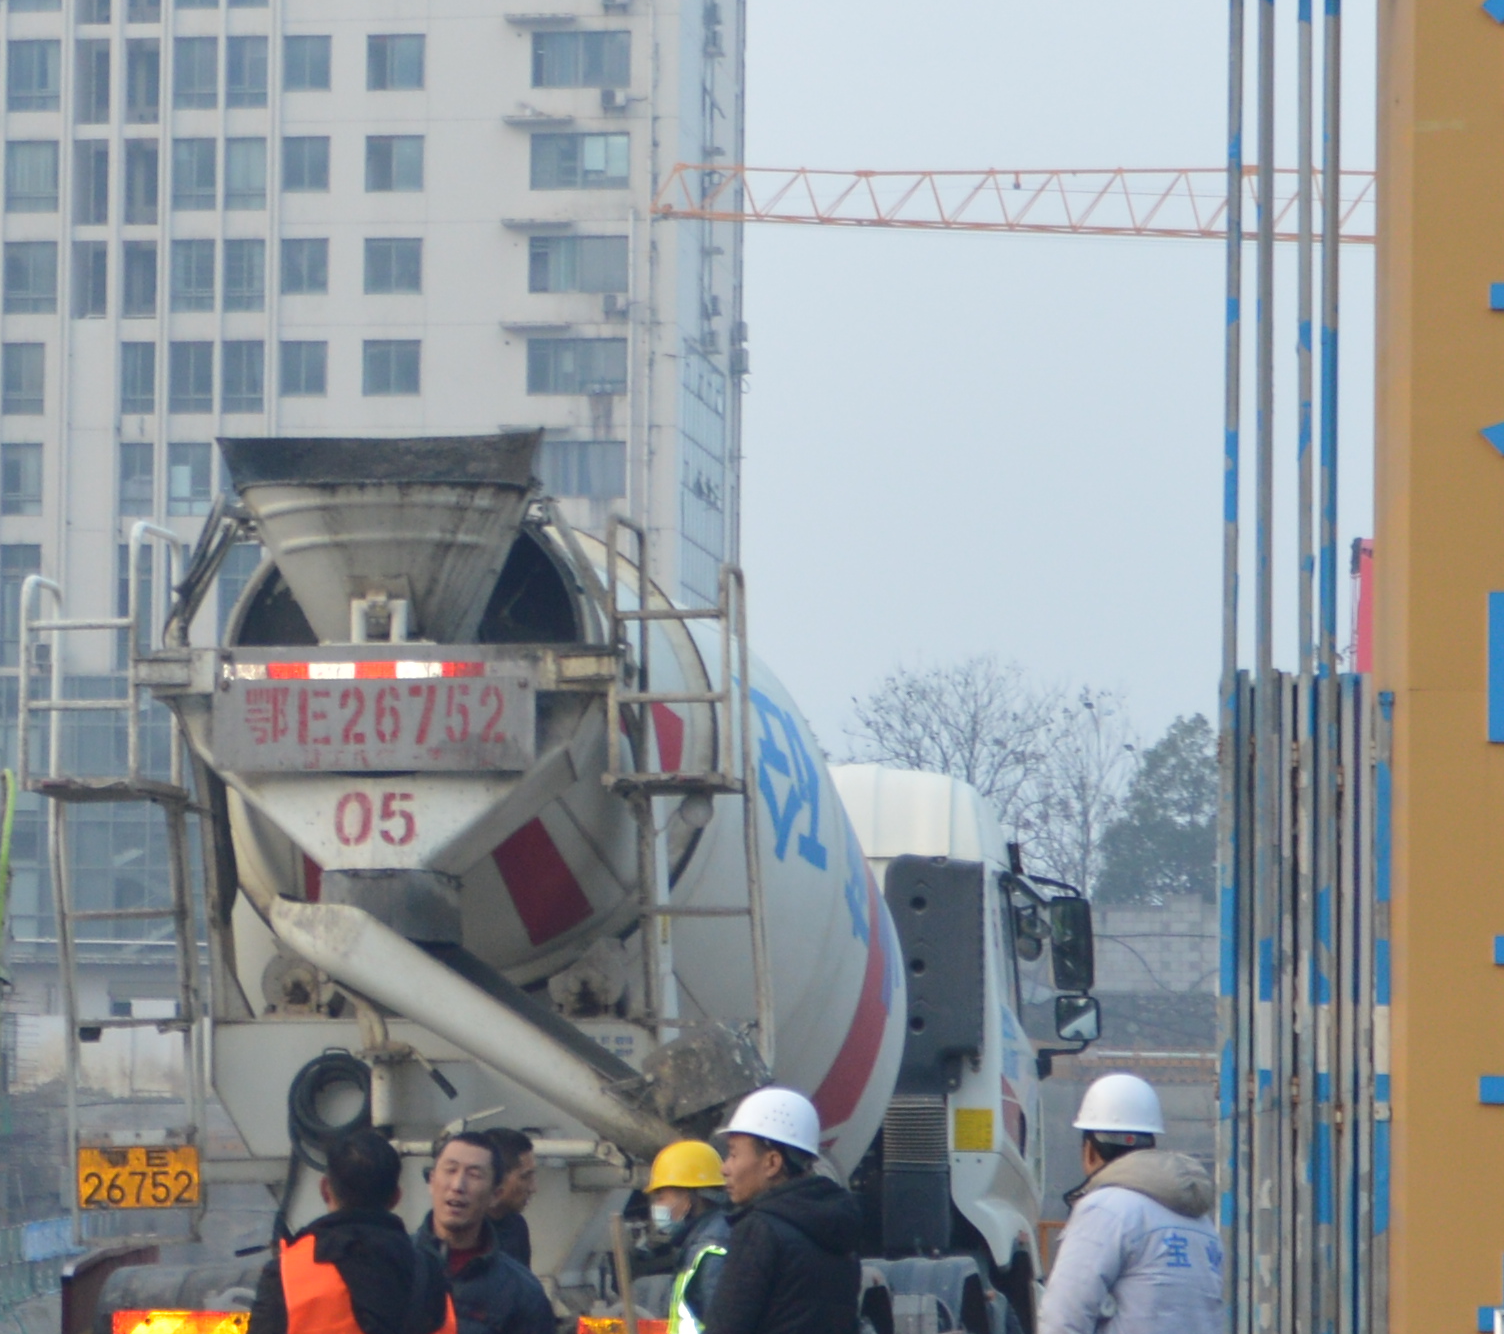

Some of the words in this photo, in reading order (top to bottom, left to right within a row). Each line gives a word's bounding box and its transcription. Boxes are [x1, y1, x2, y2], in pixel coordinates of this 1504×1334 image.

[245, 684, 506, 746] 鄂E26752
[334, 792, 417, 847] 05
[84, 1170, 193, 1205] 26752
